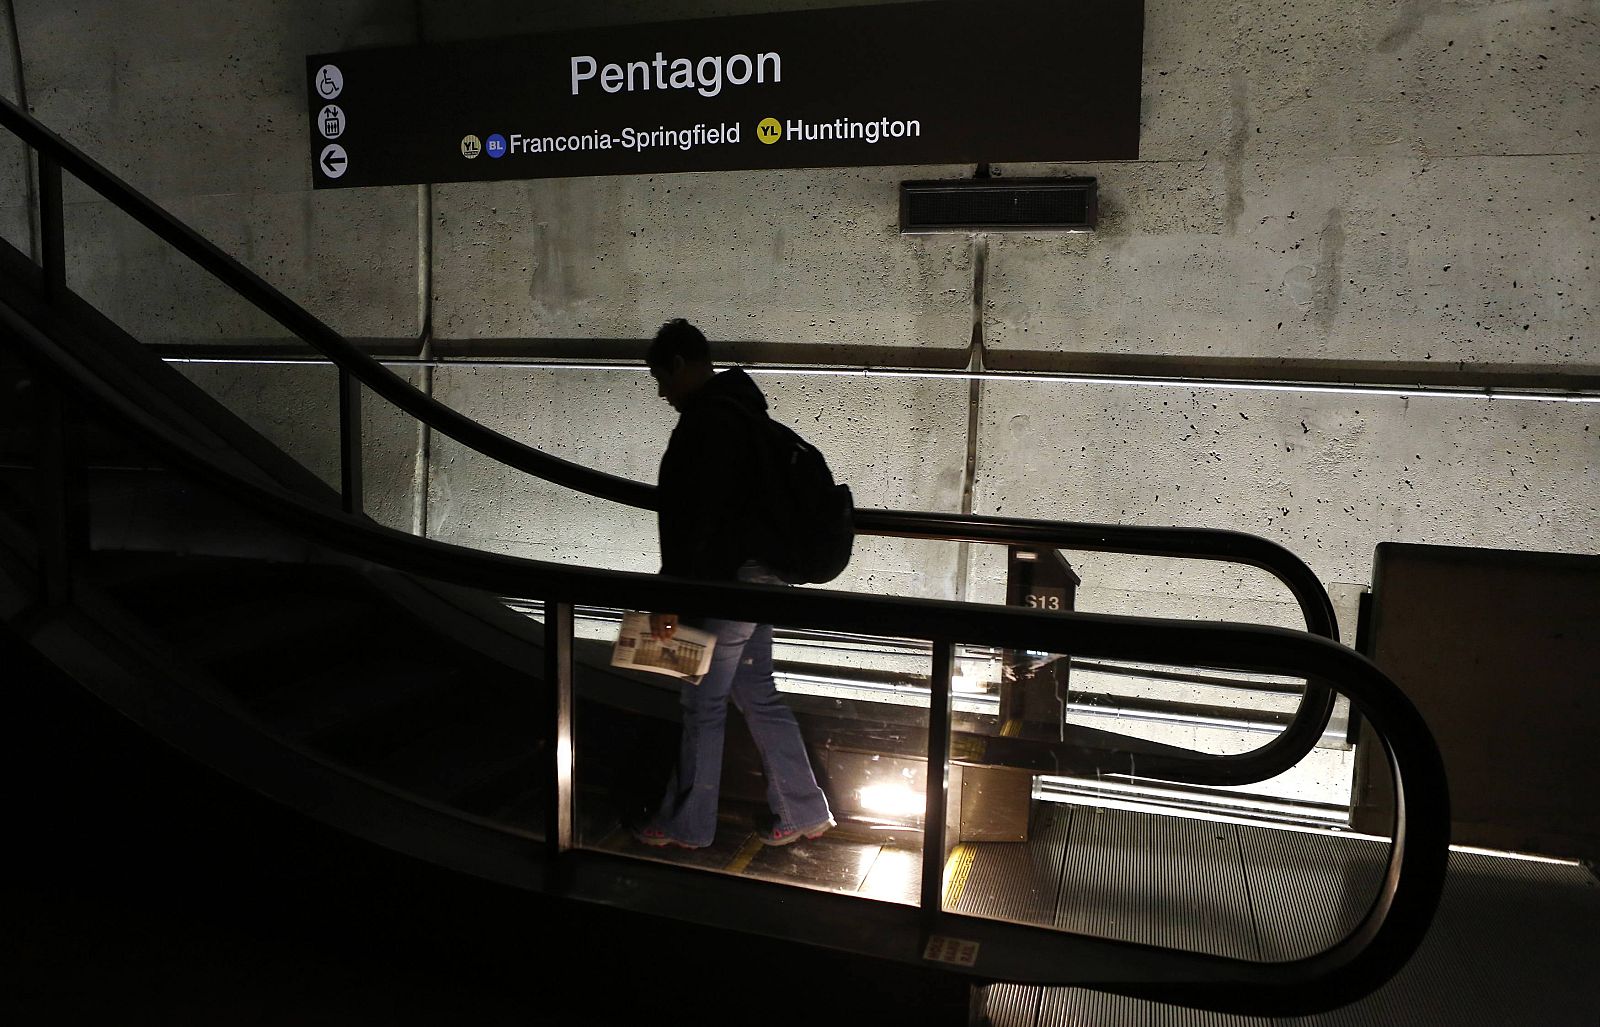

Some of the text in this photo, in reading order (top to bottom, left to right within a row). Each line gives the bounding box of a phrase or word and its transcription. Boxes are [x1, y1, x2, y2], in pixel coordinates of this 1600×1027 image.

[570, 51, 782, 98] Pentagon
[488, 140, 504, 151] BL
[510, 122, 741, 154] Franconia-Springfield
[760, 125, 779, 136] YL
[786, 116, 921, 144] Huntington
[1025, 595, 1060, 611] S13
